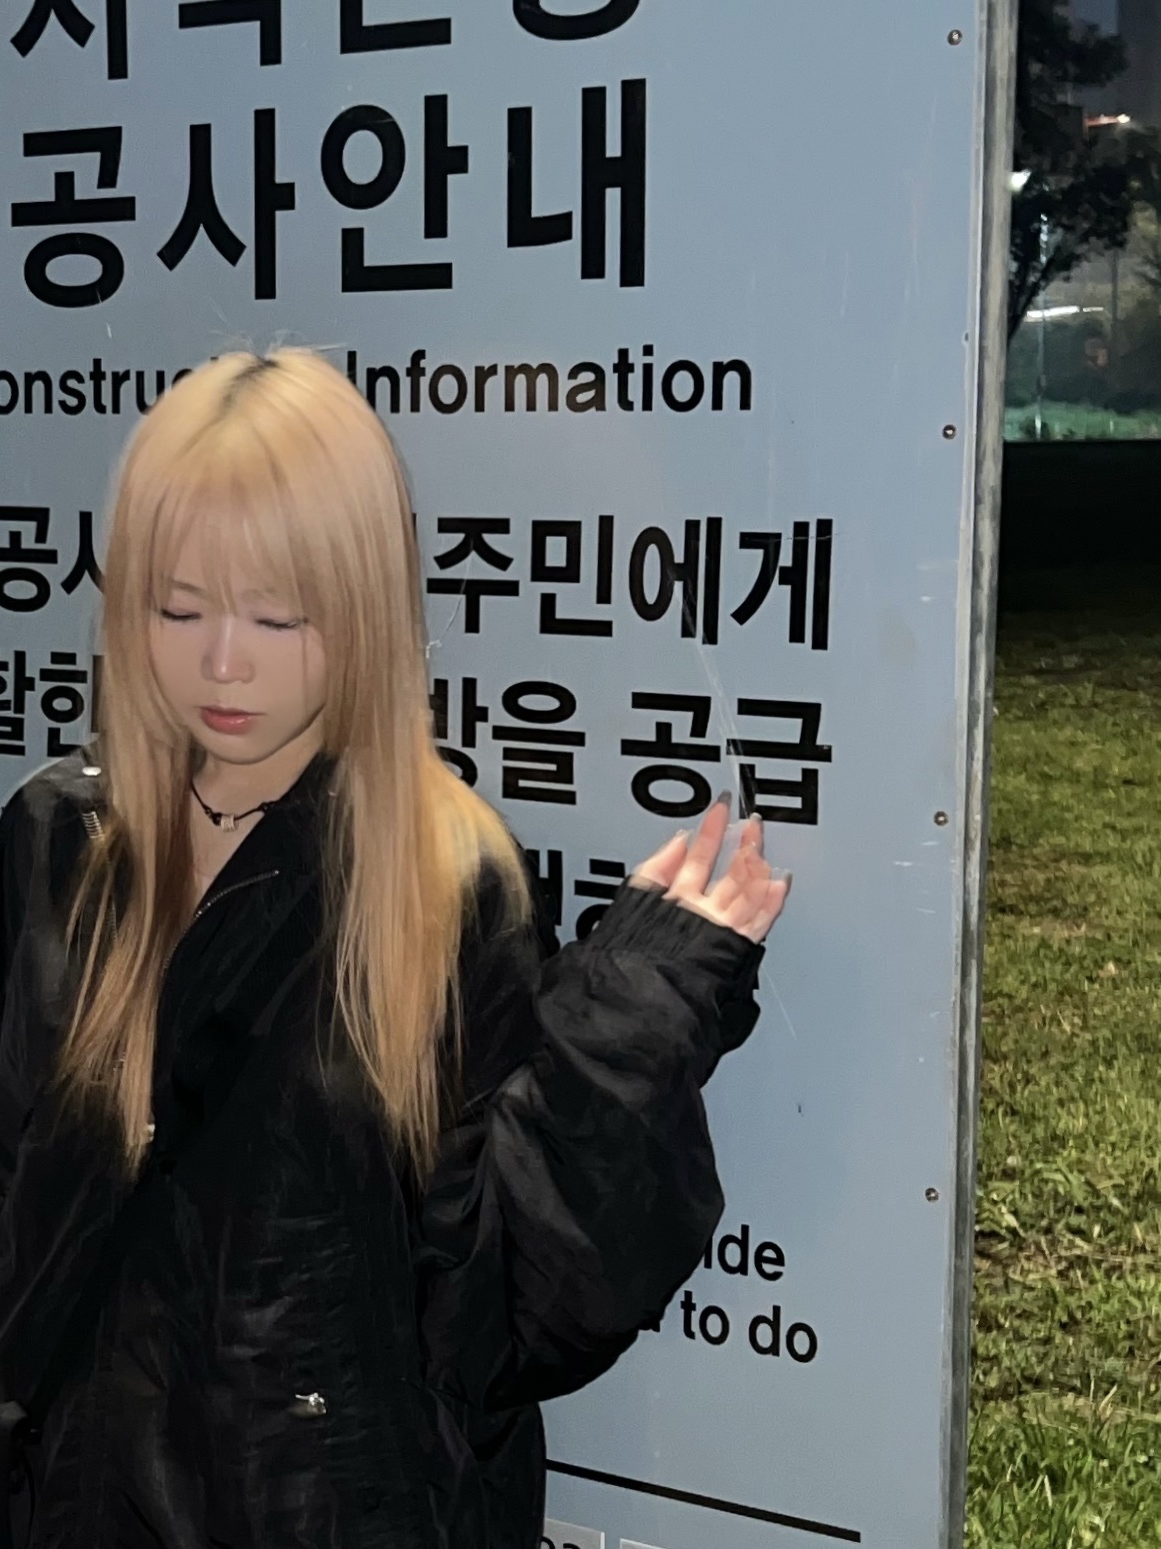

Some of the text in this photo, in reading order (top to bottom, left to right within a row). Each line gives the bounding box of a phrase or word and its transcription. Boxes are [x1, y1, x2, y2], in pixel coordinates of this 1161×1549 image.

[10, 78, 646, 308] 공사안내
[346, 344, 752, 415] Information
[412, 512, 833, 652] 주민에게
[621, 691, 832, 826] 공급
[680, 1290, 818, 1364] to do
